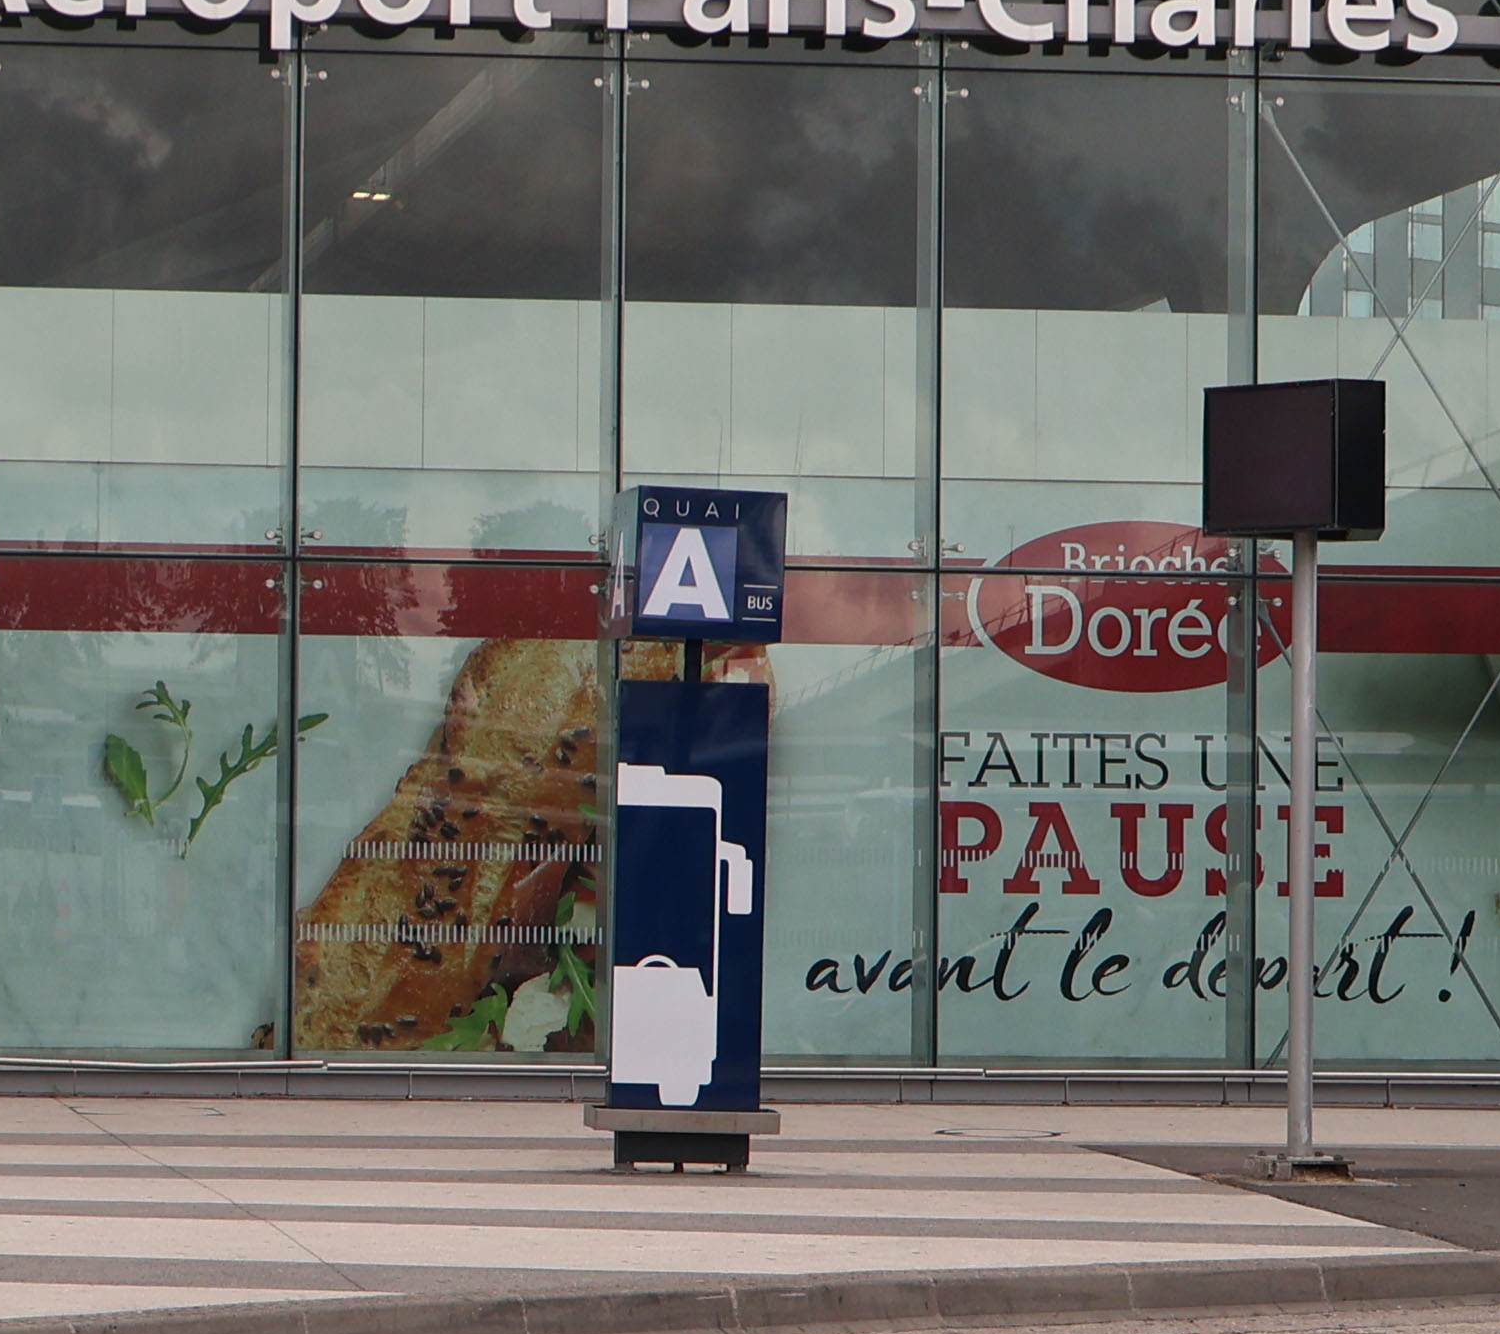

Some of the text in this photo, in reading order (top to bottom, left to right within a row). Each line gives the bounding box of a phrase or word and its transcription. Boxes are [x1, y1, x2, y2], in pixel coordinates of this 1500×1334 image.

[643, 498, 740, 520] QUAI
[642, 527, 730, 619] A
[747, 596, 773, 610] BUS
[939, 731, 1169, 791] FAITES
[1060, 907, 1132, 1002] le
[1162, 905, 1444, 1004] dprt
